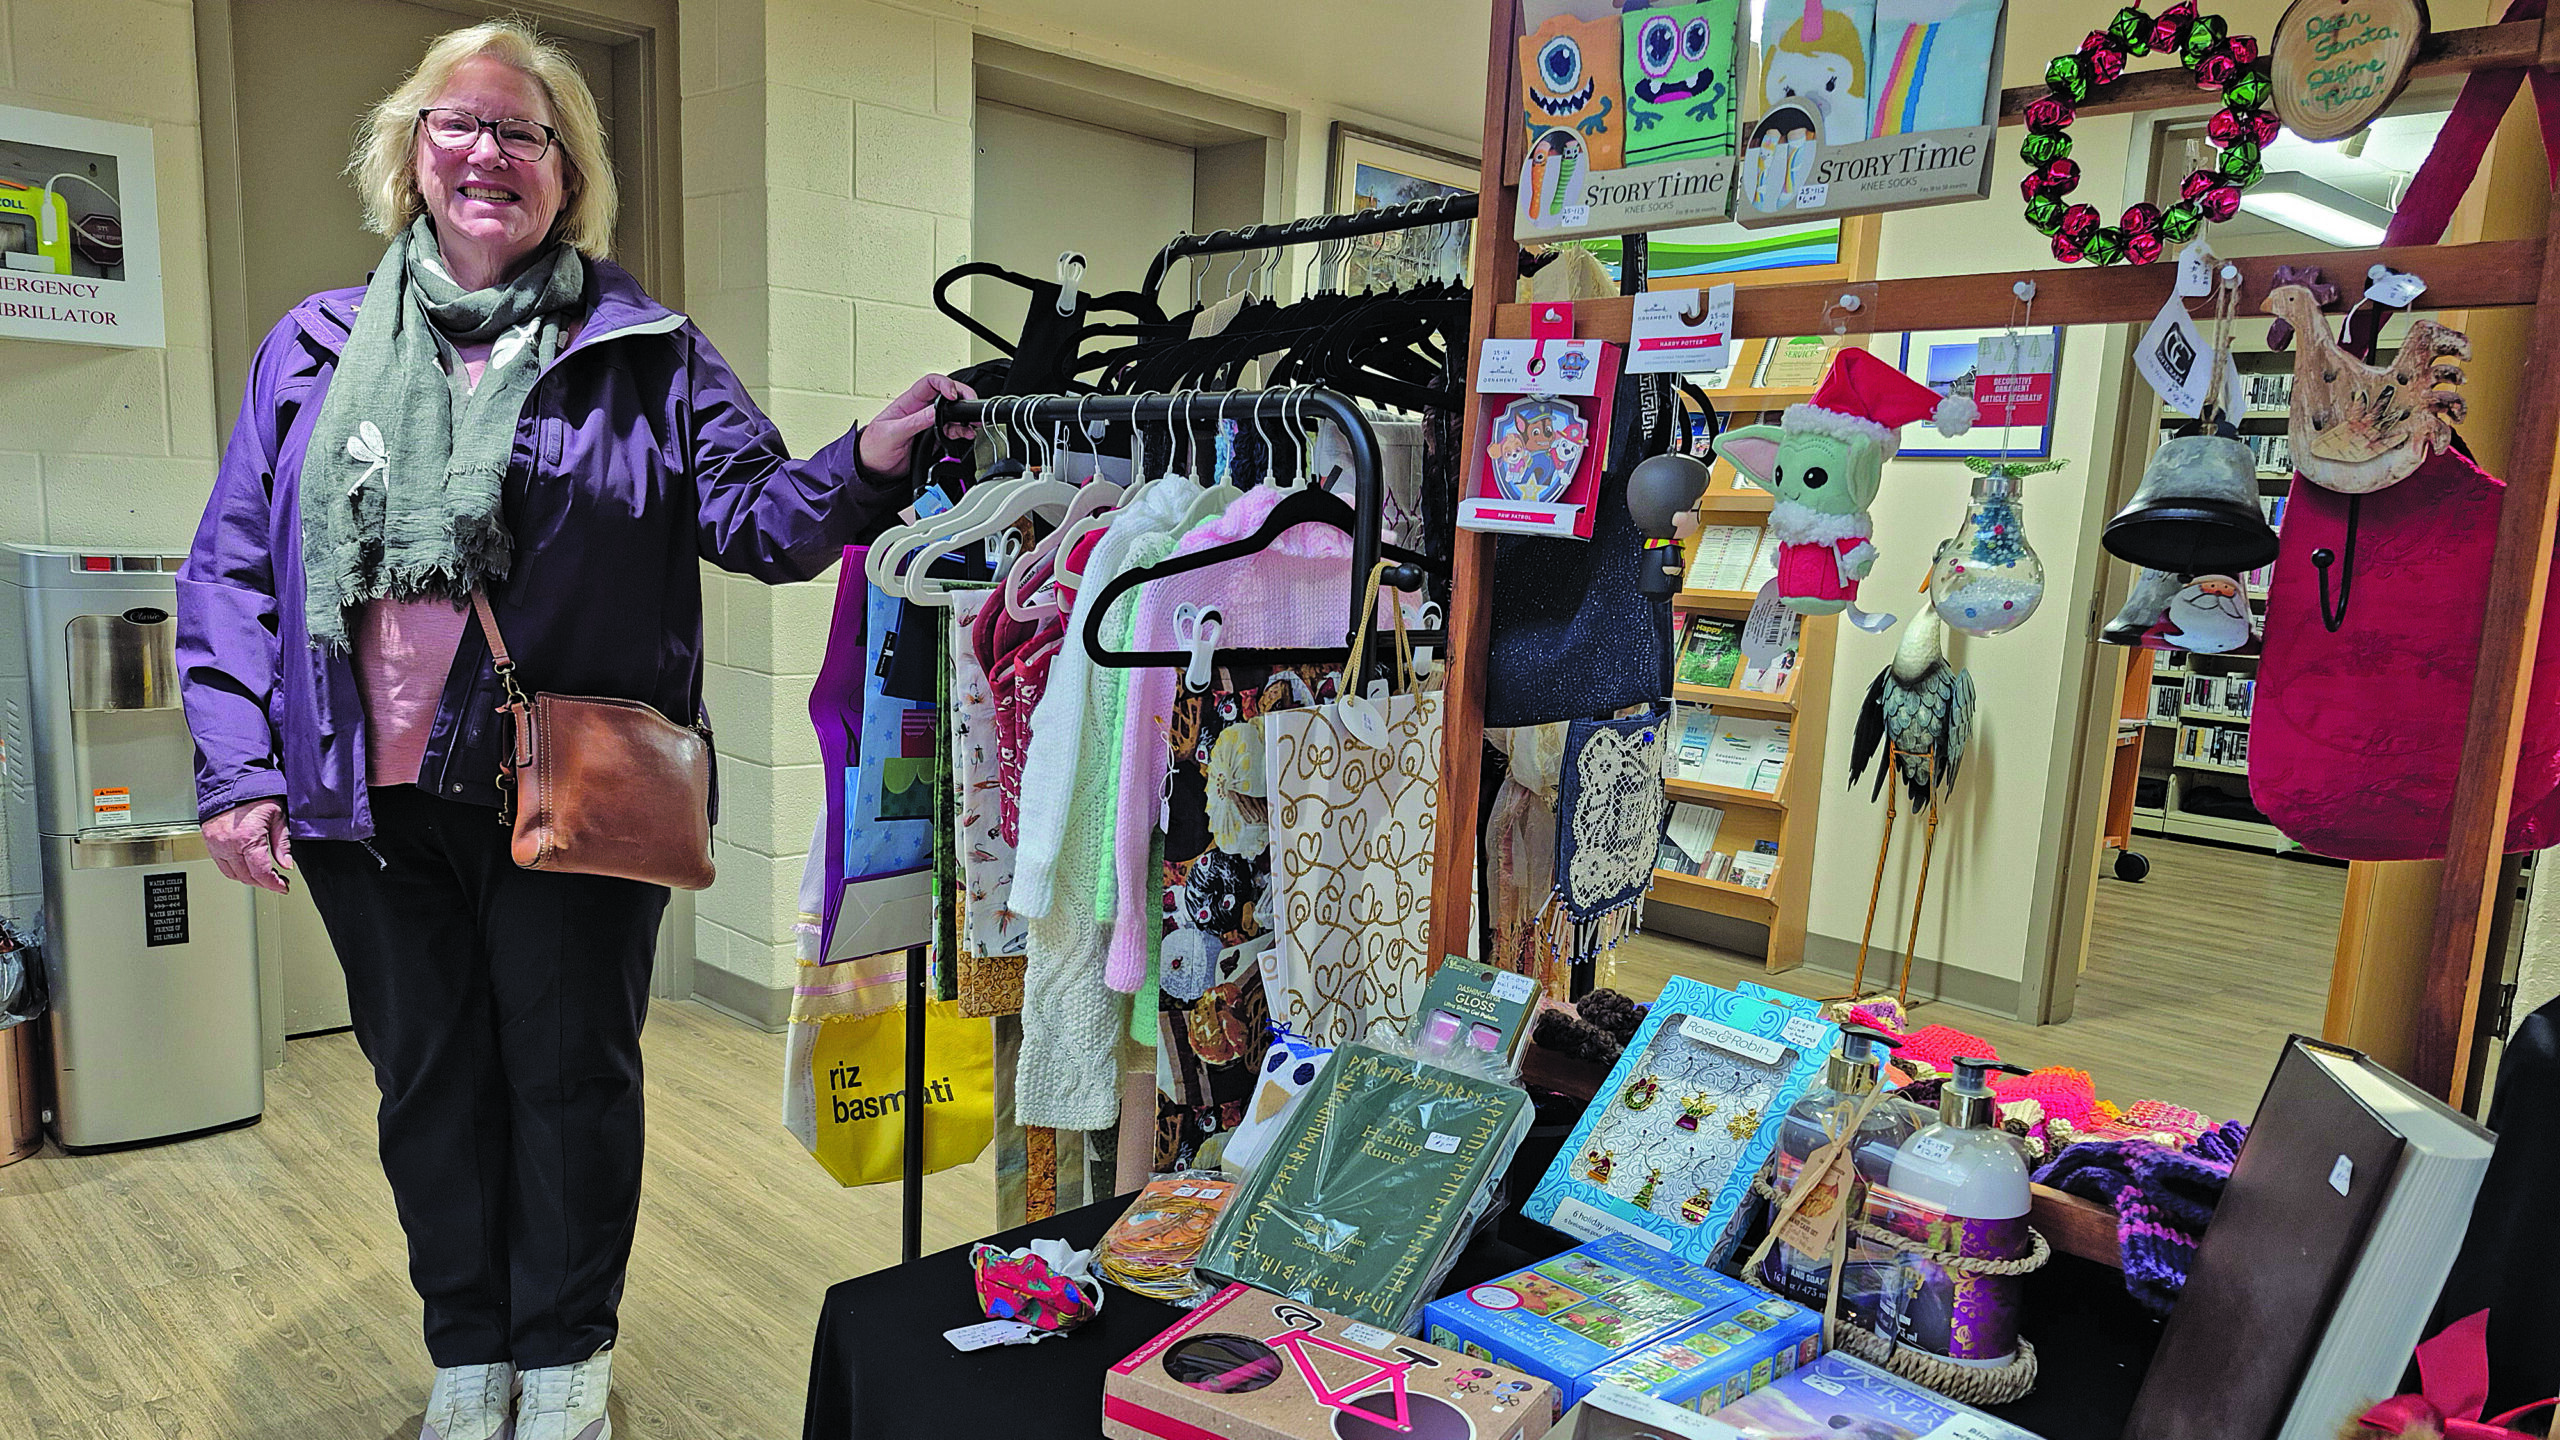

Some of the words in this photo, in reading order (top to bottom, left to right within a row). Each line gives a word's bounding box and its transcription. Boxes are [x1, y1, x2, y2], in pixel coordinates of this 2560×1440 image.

[2306, 13, 2370, 42] Dear
[2307, 58, 2386, 90] Define
[1861, 180, 1884, 192] KNEE
[1888, 177, 1918, 188] SOCKS
[0, 199, 25, 210] OLL
[1624, 204, 1645, 215] KNEE
[1648, 201, 1674, 211] SOCKS
[0, 276, 99, 299] ERGENCY
[1980, 394, 2007, 403] ARTICLE
[1696, 624, 1722, 634] Happy
[152, 886, 173, 894] DONATED
[166, 909, 185, 917] SERVICE
[1457, 984, 1485, 998] DASHING
[1443, 1000, 1456, 1009] Ultra
[1455, 993, 1496, 1013] GLOSS
[829, 1060, 862, 1090] riz
[1387, 1115, 1417, 1135] The
[1361, 1124, 1423, 1157] Healing
[1361, 1140, 1406, 1165] Runes
[1579, 1211, 1604, 1230] holiday
[1292, 1236, 1317, 1252] Susan
[1774, 1272, 1781, 1282] 16
[1802, 1285, 1817, 1296] 473
[1806, 1274, 1825, 1285] SOAP
